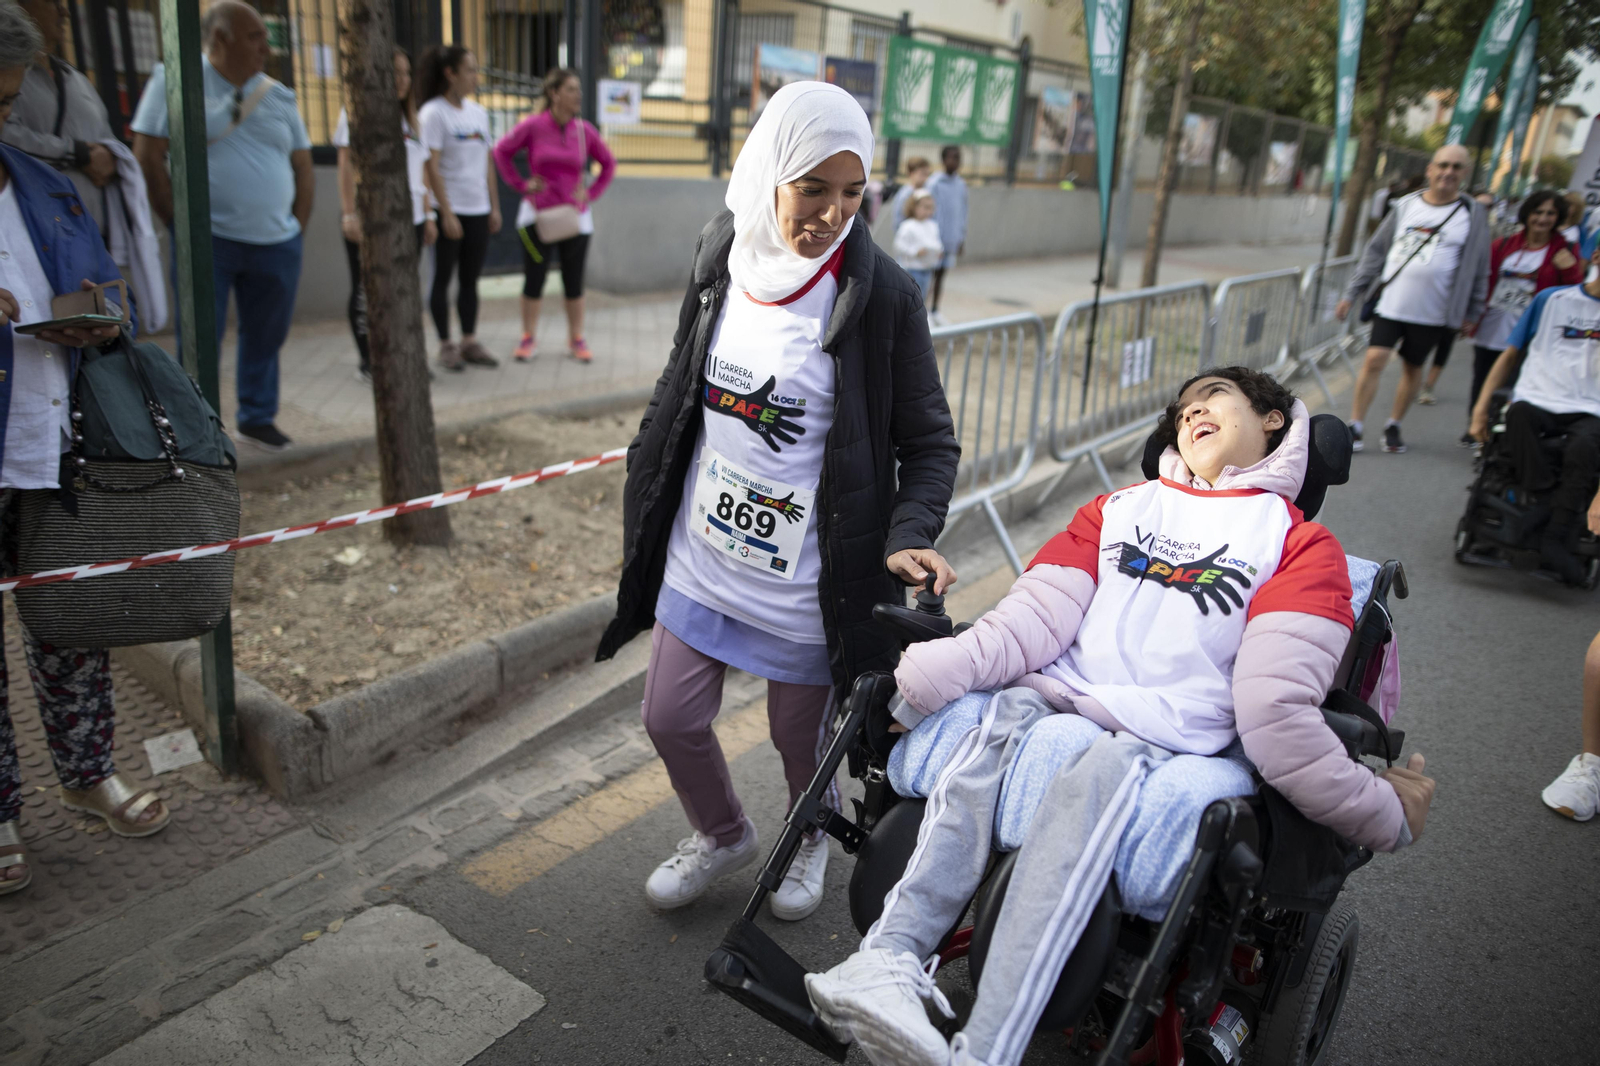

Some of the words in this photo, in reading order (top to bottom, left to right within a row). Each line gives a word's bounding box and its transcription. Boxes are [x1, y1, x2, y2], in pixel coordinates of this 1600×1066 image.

[719, 360, 753, 380] CARRERA
[718, 372, 752, 392] MARCHA
[771, 393, 779, 403] 16
[780, 396, 797, 405] OCT
[727, 468, 749, 486] CARRERA
[749, 480, 773, 495] MARCHA
[750, 493, 795, 512] ASPACE
[716, 491, 776, 539] 869
[1157, 534, 1201, 551] CARRERA
[1154, 545, 1195, 561] MARCHA
[1228, 557, 1248, 569] OCT
